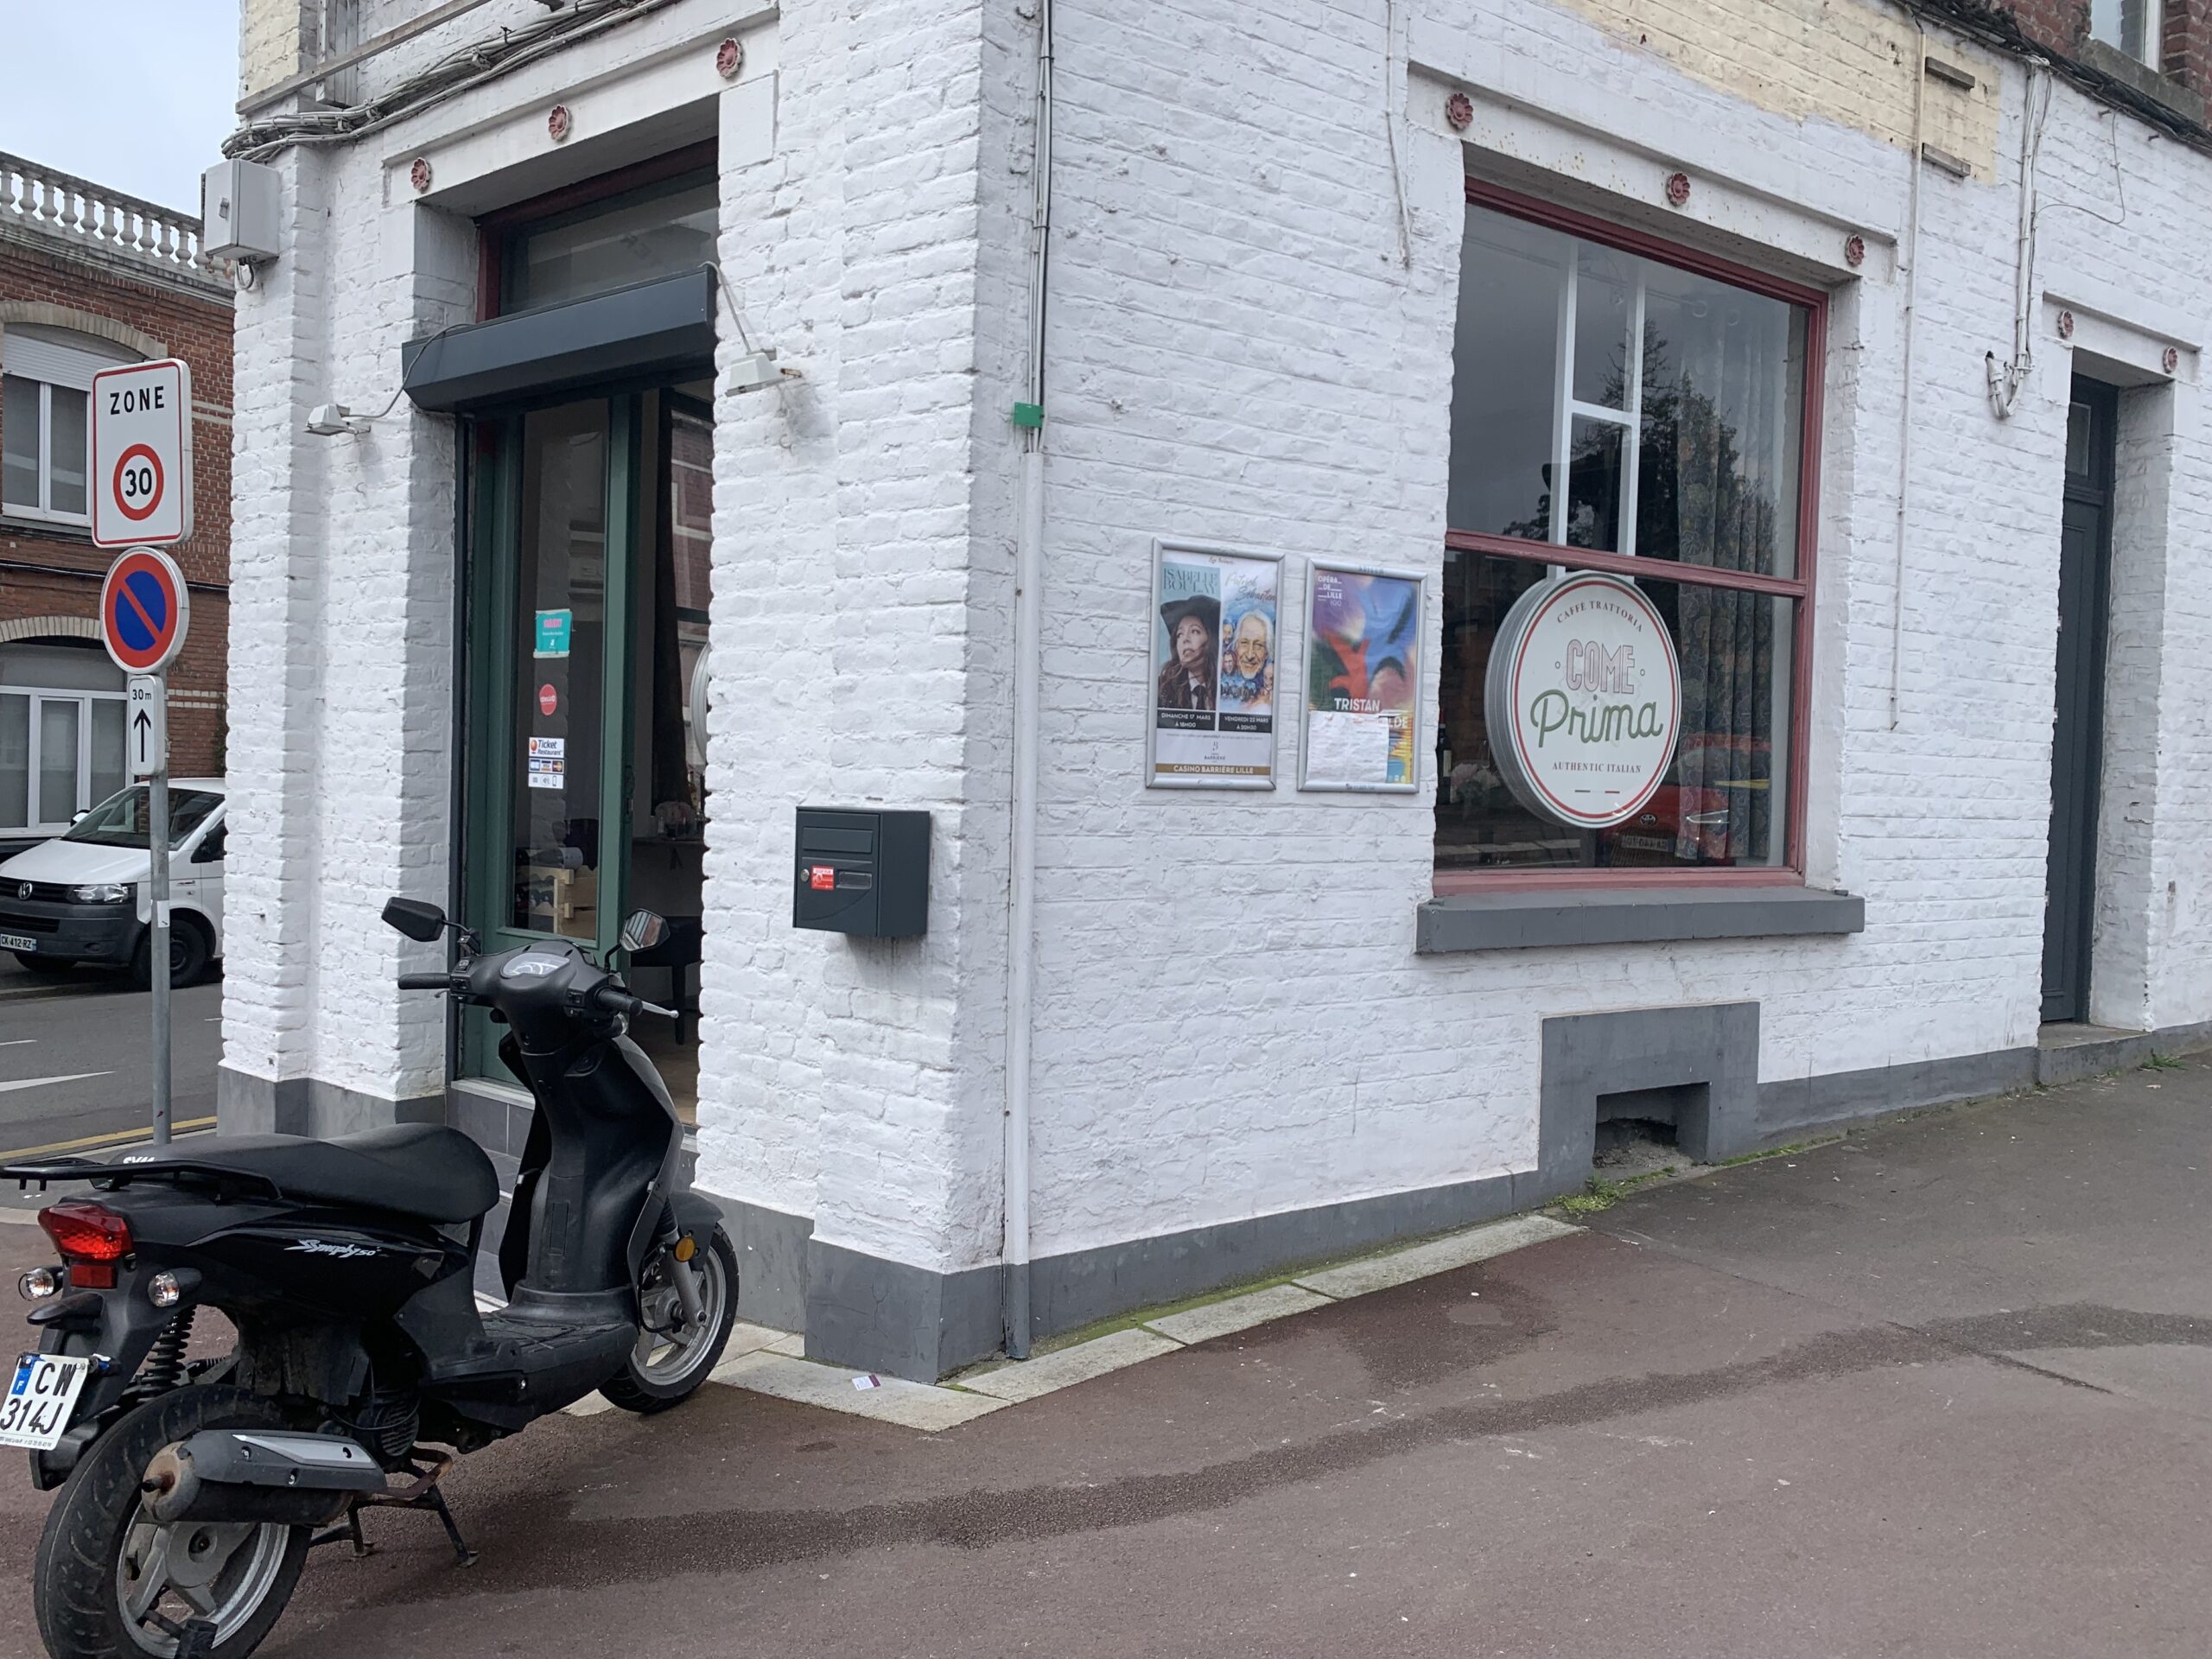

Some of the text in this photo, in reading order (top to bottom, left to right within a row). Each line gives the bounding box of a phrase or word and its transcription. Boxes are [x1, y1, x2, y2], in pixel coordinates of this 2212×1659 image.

[110, 385, 164, 415] ZONE
[124, 467, 152, 497] 30
[1163, 568, 1218, 586] ISABELLE
[1327, 591, 1342, 600] LILLE
[1589, 600, 1643, 632] TRATTORIA
[1566, 639, 1636, 695] COME
[1334, 697, 1381, 712] TRISTAN
[1530, 689, 1664, 748] Prima
[537, 740, 557, 749] Ticket
[1553, 761, 1642, 773] AUTHENTIC ITALIAN
[16, 1380, 24, 1391] F
[35, 1363, 78, 1396] CW
[0, 1398, 64, 1434] 314J
